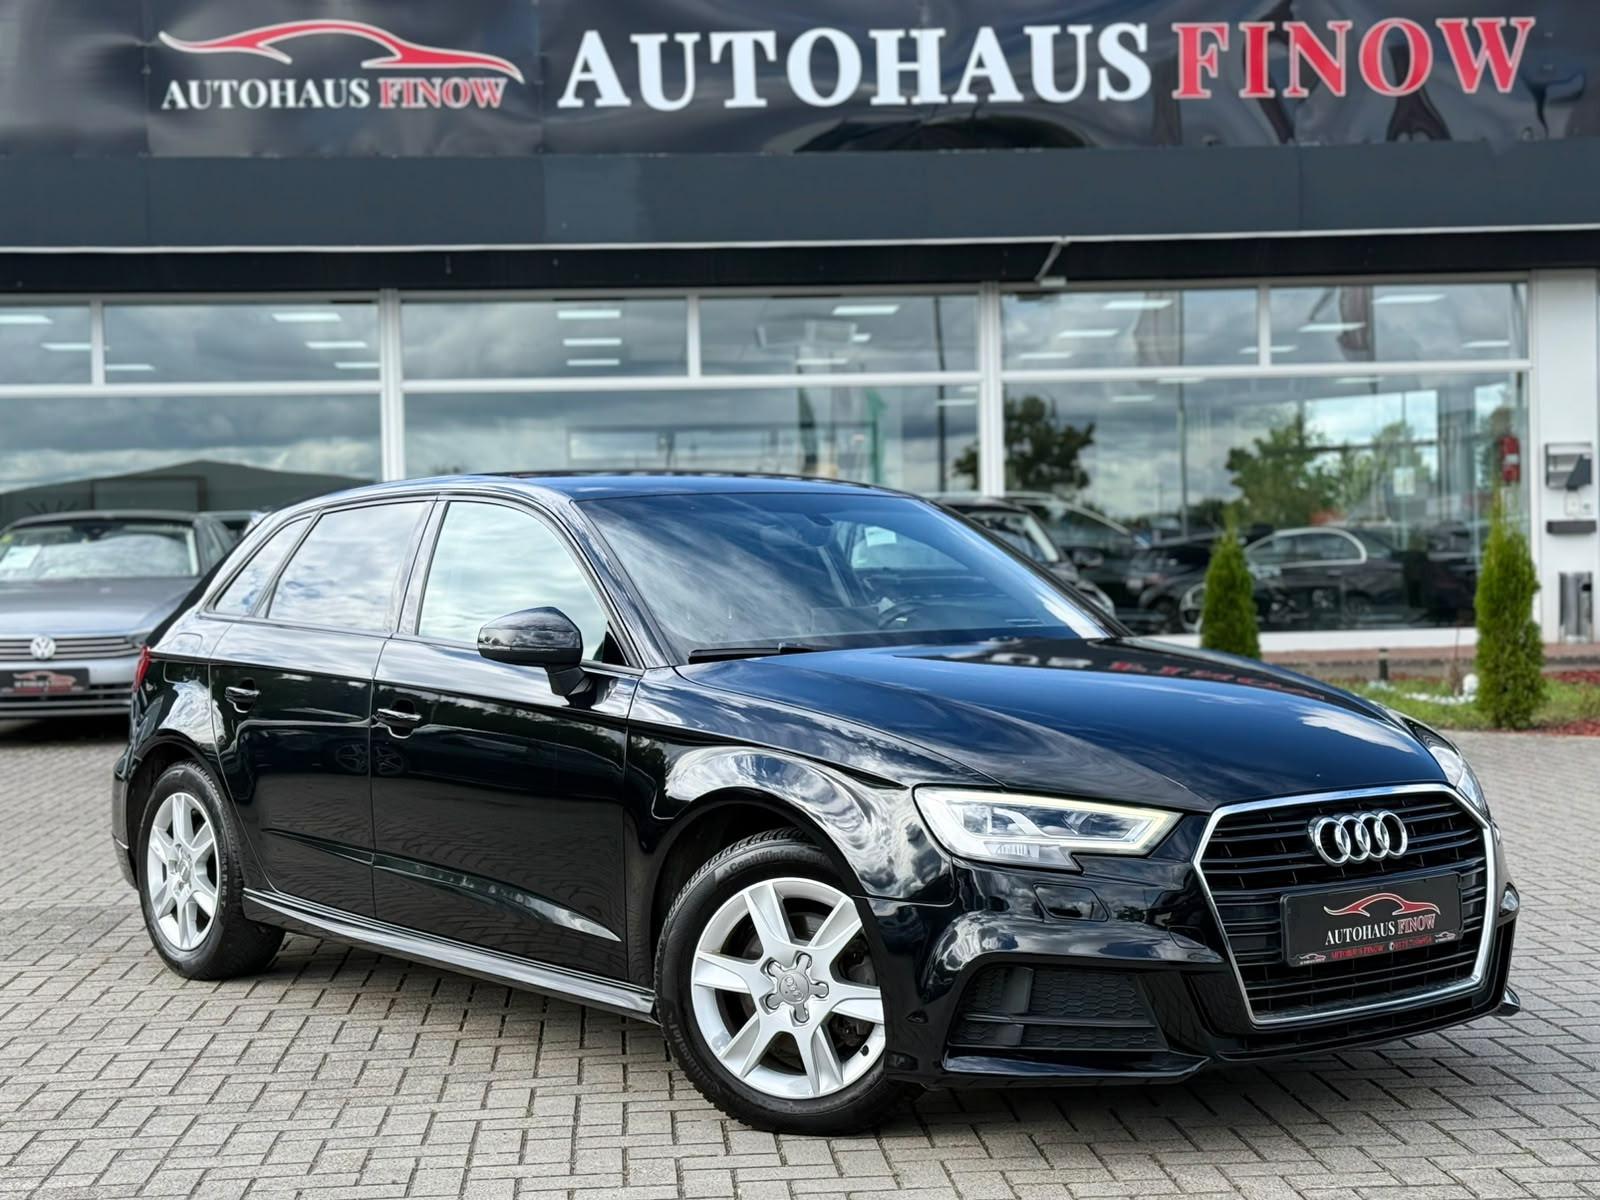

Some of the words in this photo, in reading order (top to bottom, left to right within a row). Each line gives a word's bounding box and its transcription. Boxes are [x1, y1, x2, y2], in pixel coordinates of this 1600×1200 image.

[556, 22, 1152, 111] AUTOHAUS
[1172, 16, 1536, 99] FINOW
[161, 79, 370, 110] AUTOHAUS
[378, 77, 508, 109] FINOW
[1325, 920, 1396, 946] AUTOHAUS
[1397, 913, 1436, 935] FINOW
